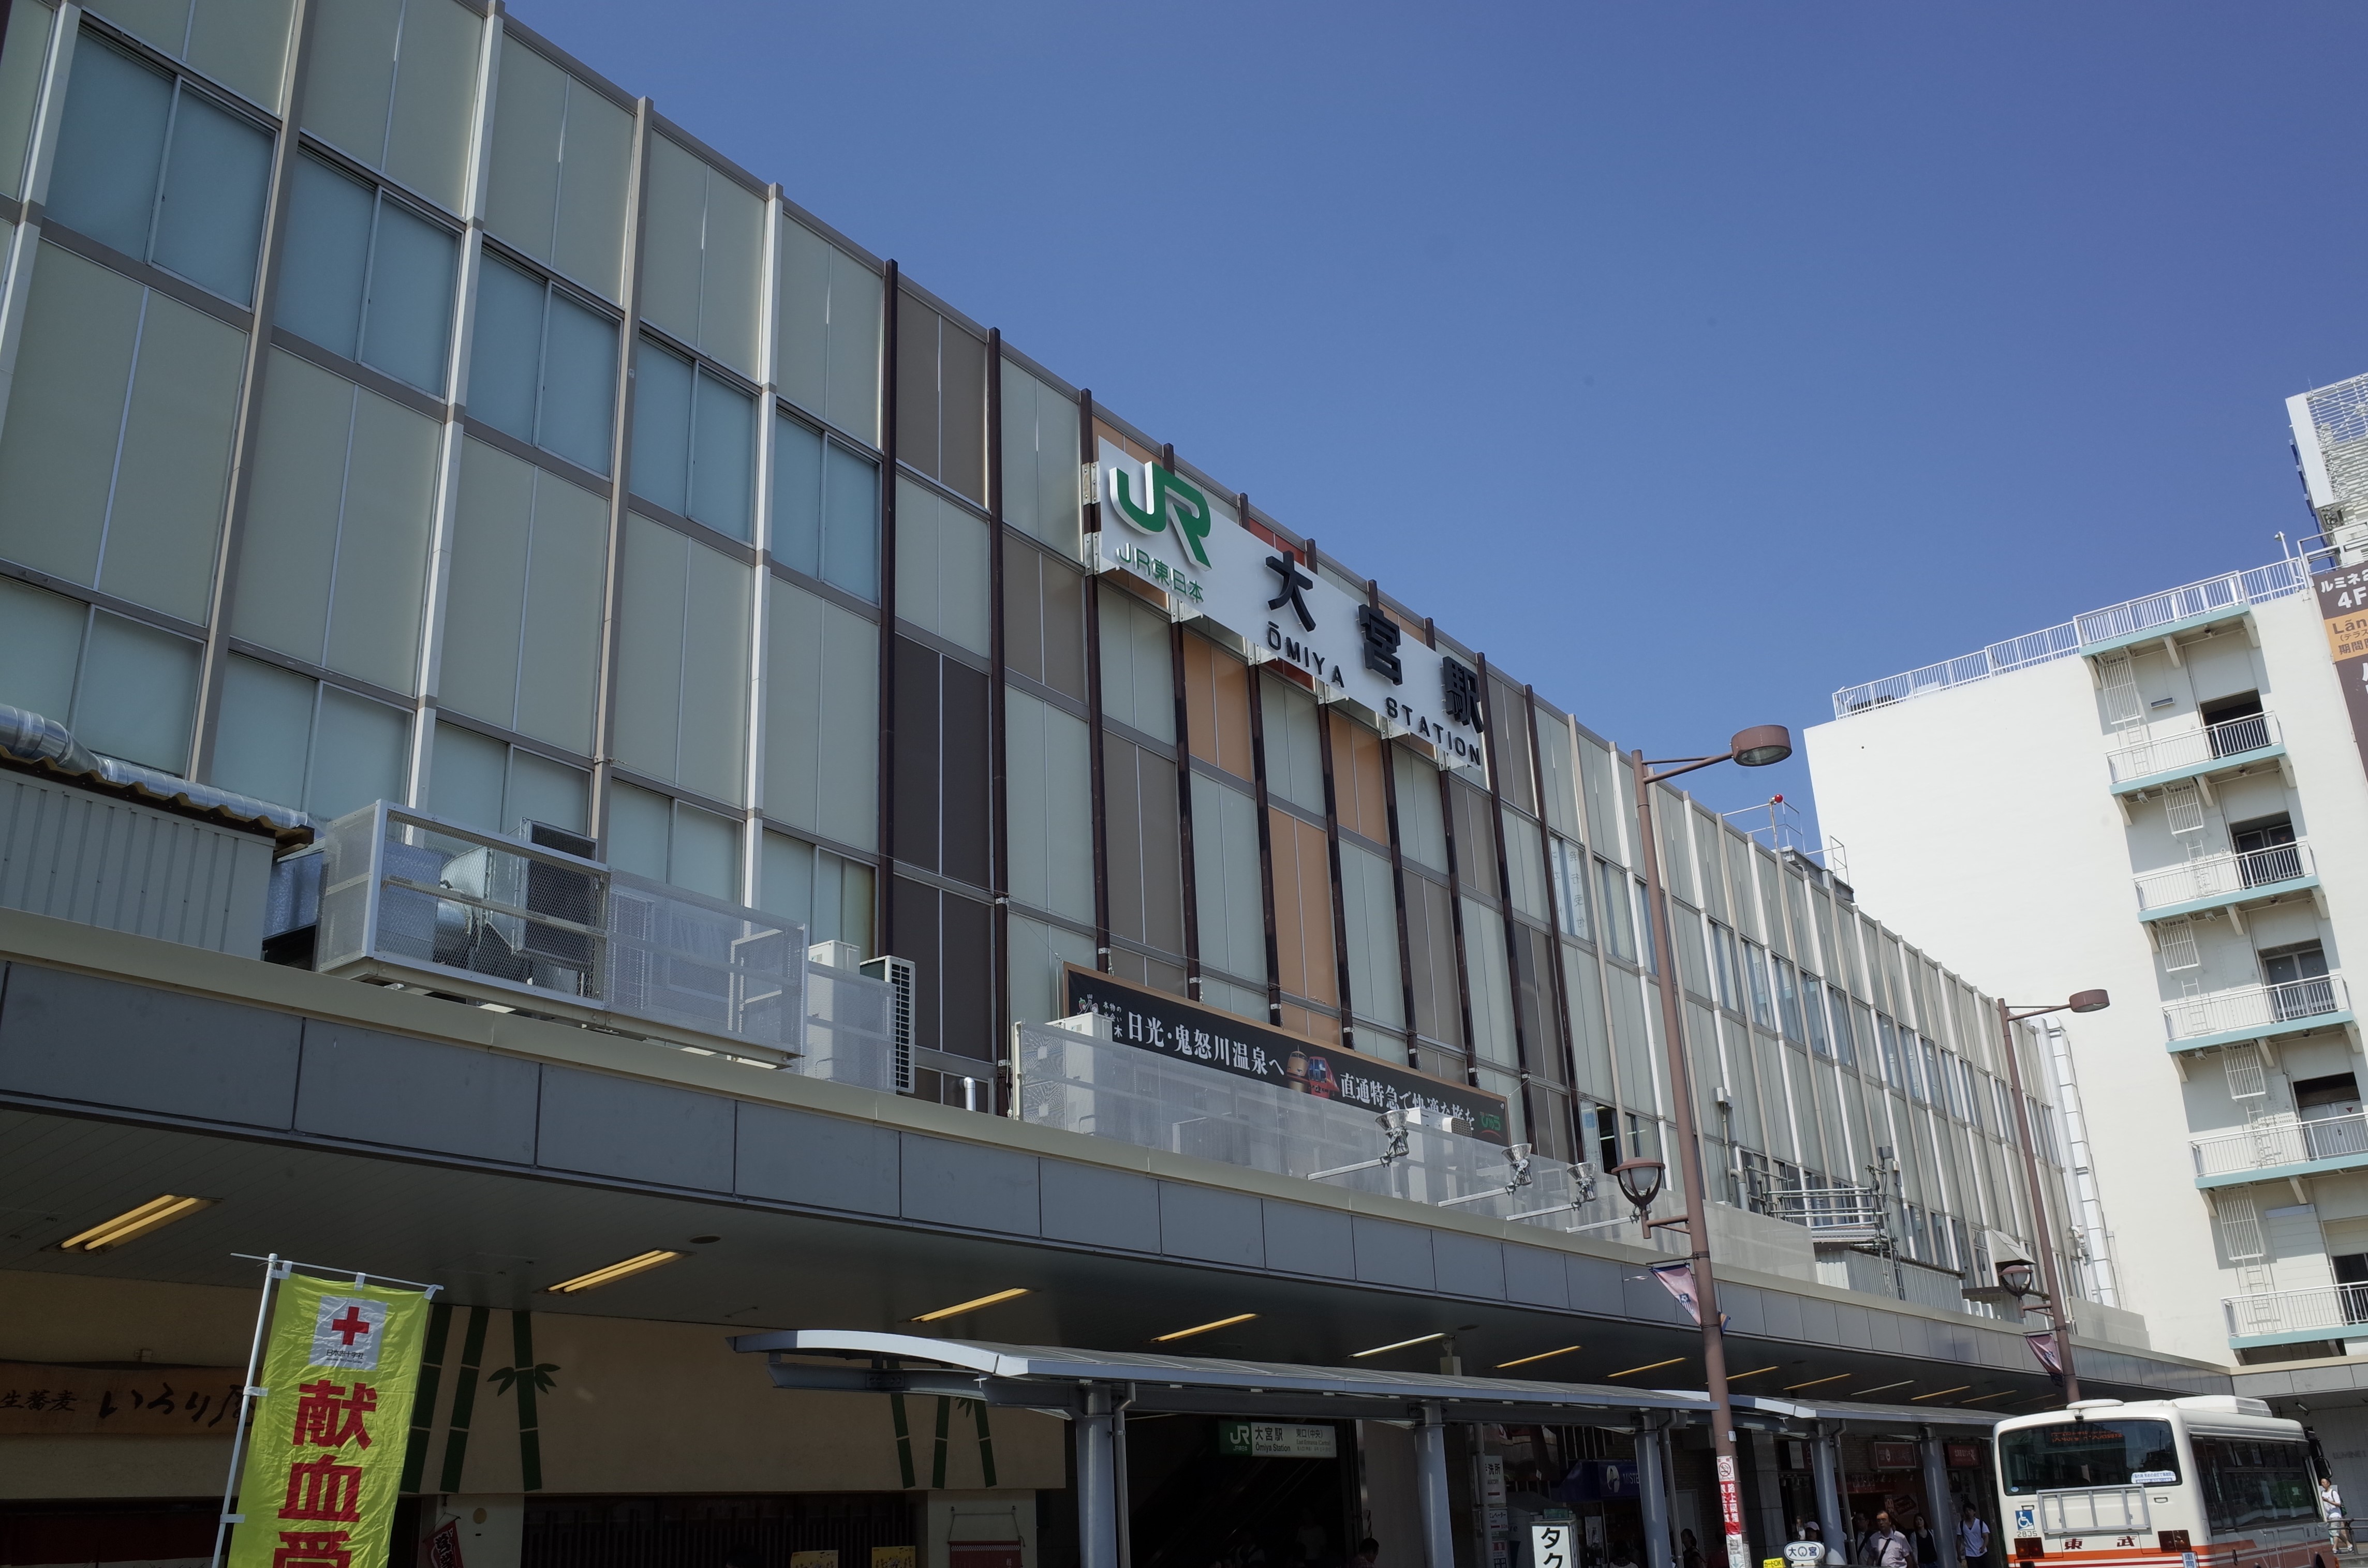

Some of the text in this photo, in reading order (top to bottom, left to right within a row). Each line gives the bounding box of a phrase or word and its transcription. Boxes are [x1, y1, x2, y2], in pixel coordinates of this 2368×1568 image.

[1109, 460, 1212, 571] JR
[1116, 543, 1204, 603] JR東日本
[2338, 586, 2366, 608] 4F
[1266, 550, 1484, 734] 大宮駅
[1267, 622, 1481, 766] ŌMIYA STATION
[1129, 1011, 1285, 1076] 日光・鬼怒川温泉へ
[1230, 1425, 1250, 1445] JR
[1255, 1426, 1283, 1442] 大宮駅
[1296, 1429, 1323, 1439] 東口(中央)
[1273, 1443, 1291, 1452] Station
[1623, 1473, 1639, 1484] MISTE
